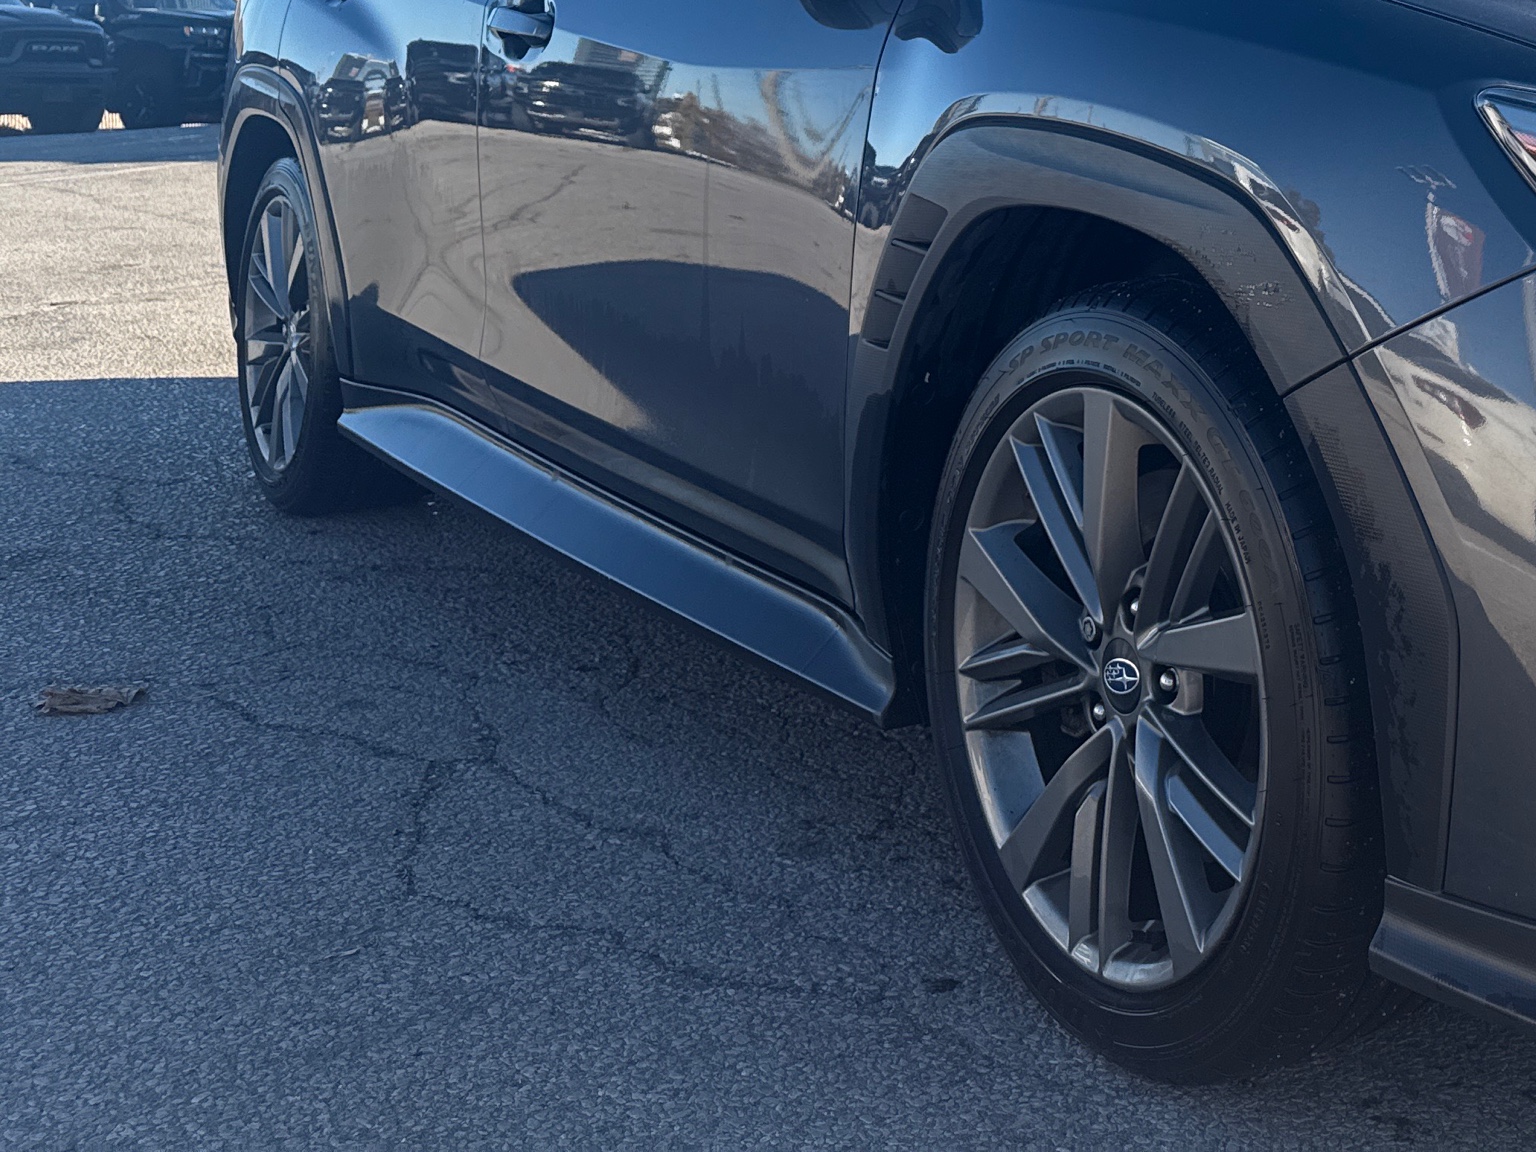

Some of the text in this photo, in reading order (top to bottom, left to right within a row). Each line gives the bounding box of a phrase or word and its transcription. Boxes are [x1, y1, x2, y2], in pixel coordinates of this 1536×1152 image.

[1008, 345, 1035, 376] SP
[1040, 330, 1120, 355] SPORT
[1122, 343, 1208, 423] MAXX
